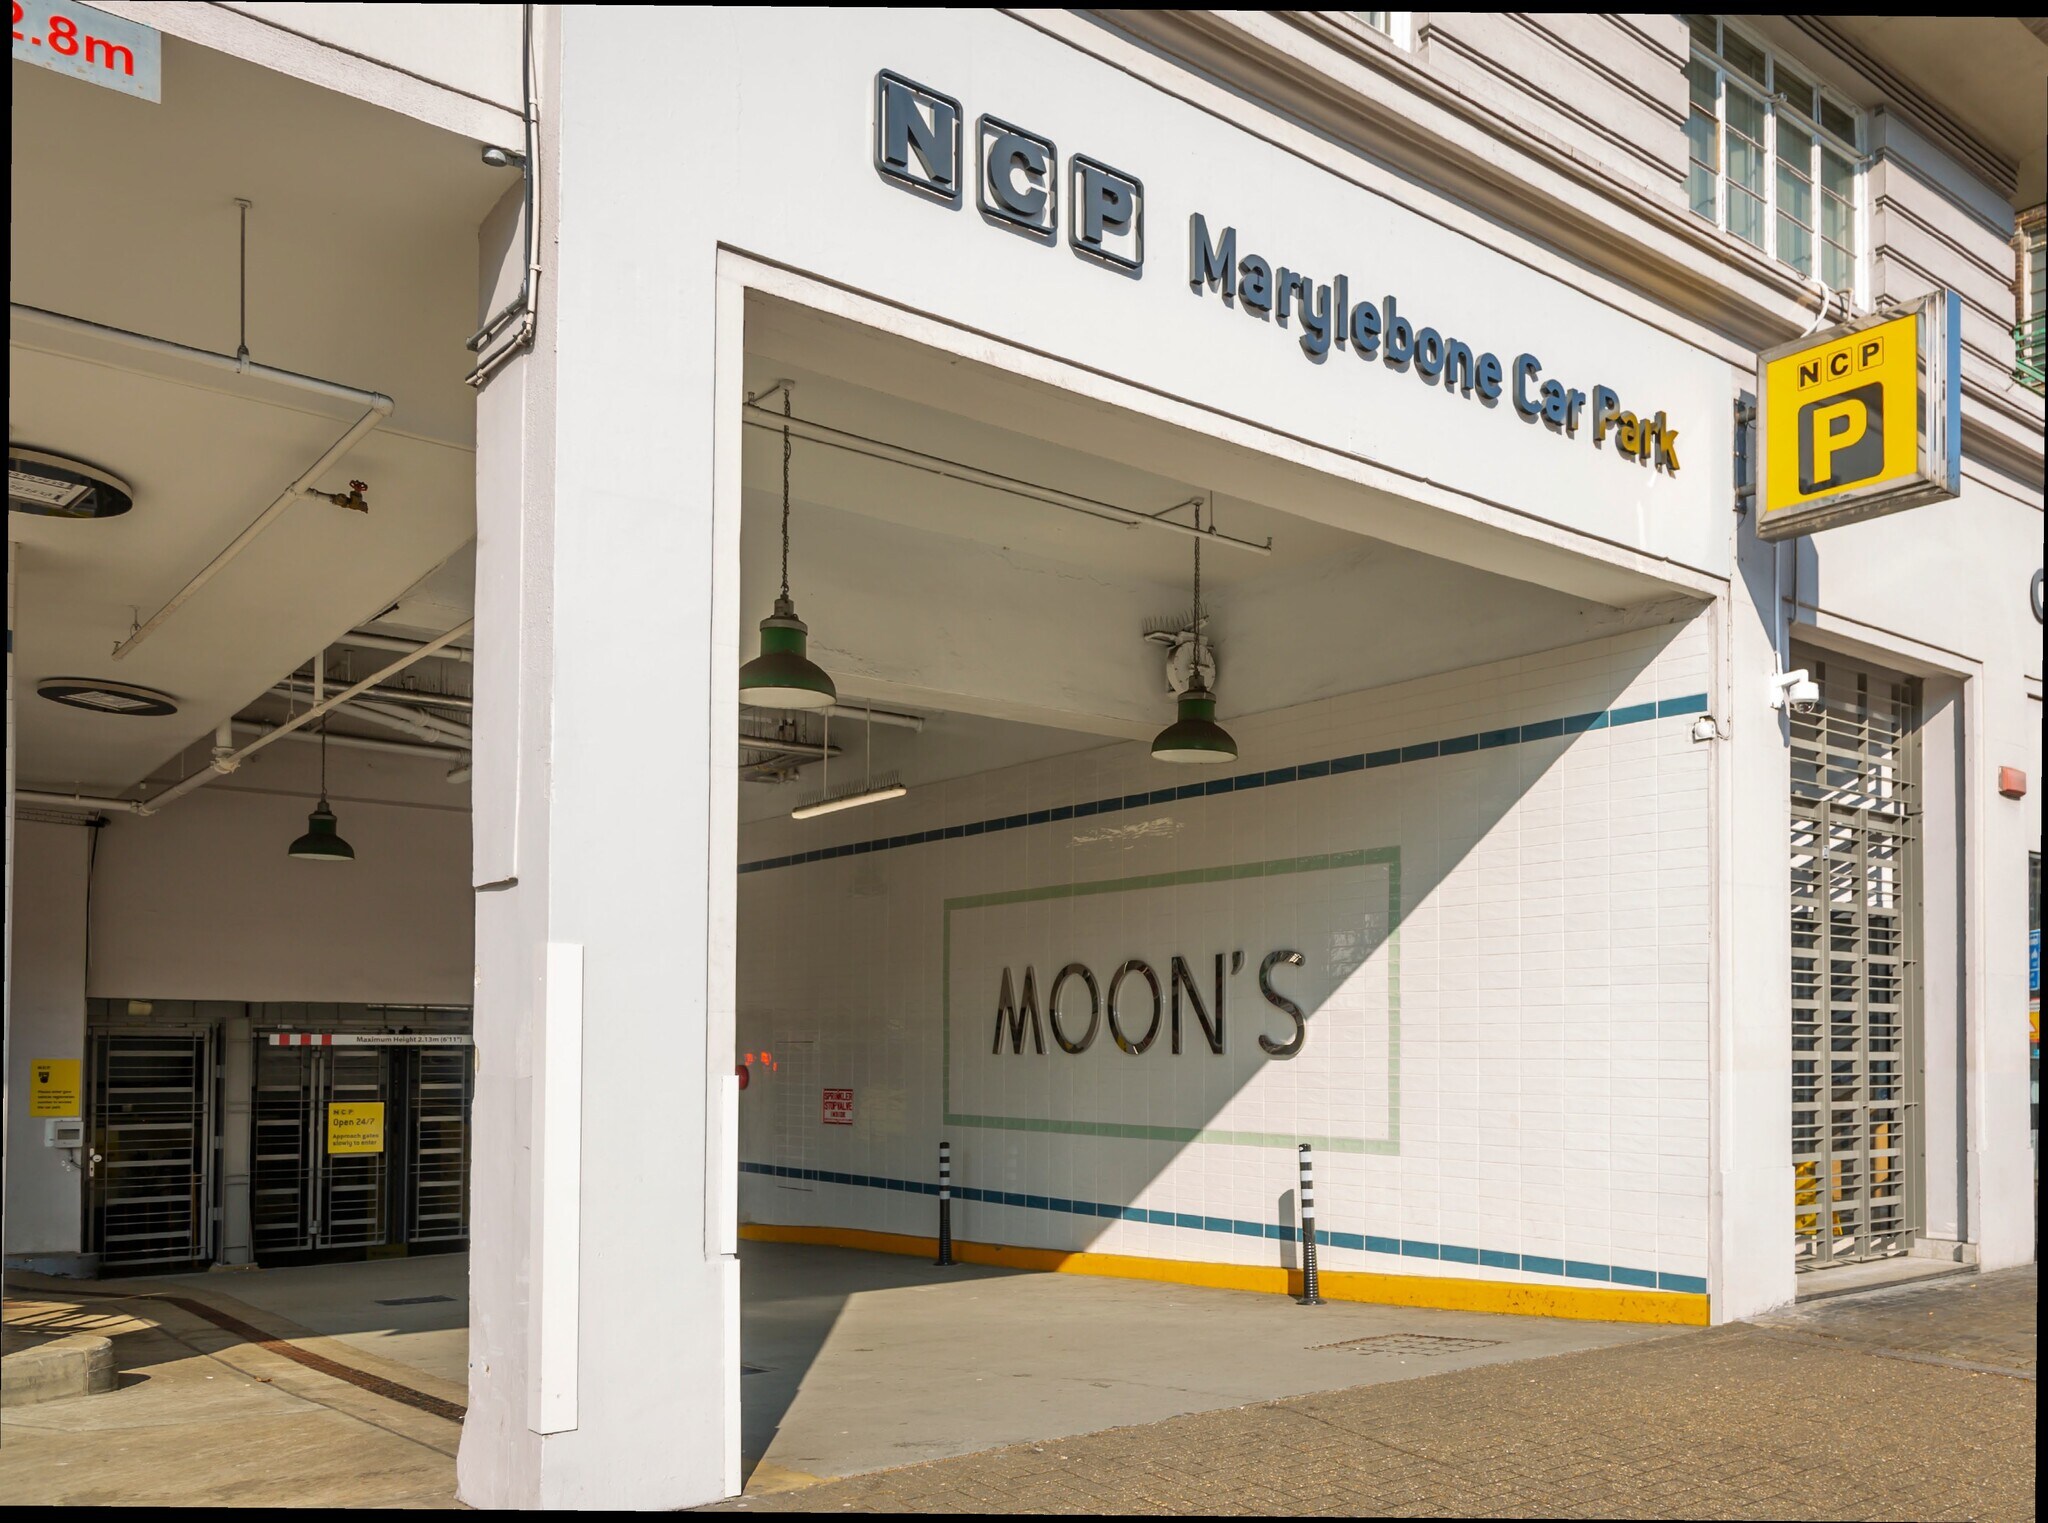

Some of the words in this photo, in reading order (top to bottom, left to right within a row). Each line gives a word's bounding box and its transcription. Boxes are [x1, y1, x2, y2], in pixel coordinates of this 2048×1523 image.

[1189, 211, 1502, 400] Marylebone
[1512, 352, 1586, 433] Car
[1592, 384, 1680, 471] Park
[1812, 398, 1868, 485] P
[992, 950, 1306, 1058] MOON'S
[393, 1036, 417, 1044] Height
[332, 1133, 361, 1141] Approach
[333, 1118, 355, 1128] Open
[355, 1117, 375, 1126] 24/7
